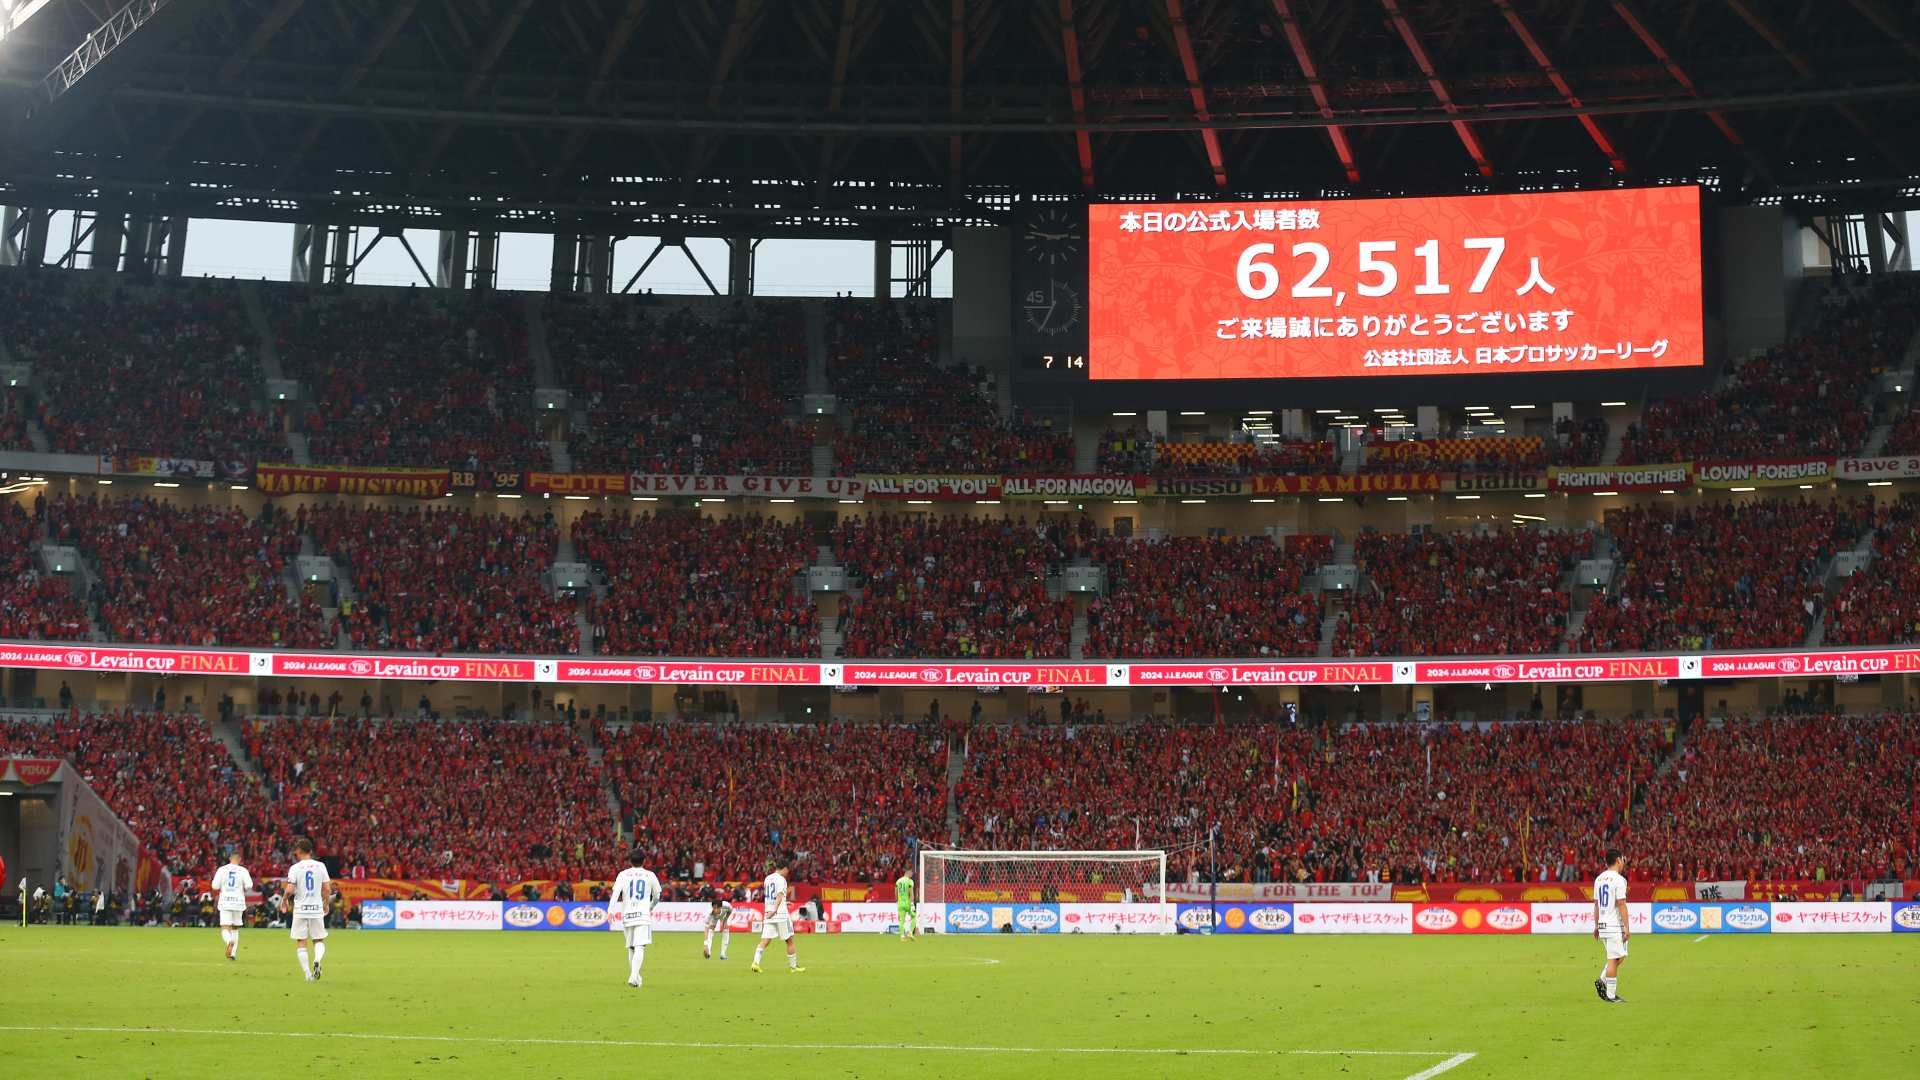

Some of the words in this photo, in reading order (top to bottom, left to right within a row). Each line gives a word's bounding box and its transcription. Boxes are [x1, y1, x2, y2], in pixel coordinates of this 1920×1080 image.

[1120, 208, 1321, 233] 本日の公式入場者数
[1216, 309, 1574, 339] ご来場誠にありがとうございます
[1364, 347, 1469, 367] 公益社団法人
[1476, 338, 1668, 364] 日本プロサッカーリーグ
[1068, 356, 1084, 368] 14
[1701, 464, 1752, 481] LOVIN'
[1757, 461, 1828, 480] FOREVER
[1844, 459, 1899, 474] Have
[338, 477, 444, 496] HISTORY
[529, 473, 625, 491] FONTE
[632, 476, 728, 492] NEVER
[743, 477, 812, 493] GIVE
[826, 480, 864, 496] UP
[868, 478, 901, 494] ALL
[903, 479, 941, 494] FOR
[1255, 477, 1288, 493] LA
[1298, 474, 1440, 494] FAMIGLIA
[1558, 471, 1614, 487] FIGHTIN'
[1616, 468, 1686, 486] TOGETHER
[1004, 478, 1036, 496] ALL
[1036, 479, 1069, 495] FOR
[1069, 479, 1136, 496] NAGOYA
[90, 652, 144, 669] Levain
[146, 657, 175, 670] CUP
[180, 656, 239, 672] FINAL
[284, 662, 306, 670] 2024
[374, 660, 428, 676] Levain
[431, 665, 460, 678] CUP
[465, 663, 524, 678] FINAL
[1427, 668, 1450, 677] 2024
[1518, 663, 1572, 679] Levain
[1574, 666, 1604, 678] CUP
[1608, 662, 1667, 677] FINAL
[1712, 663, 1735, 672] 2024
[1804, 656, 1858, 672] Levain
[1860, 658, 1888, 671] CUP
[568, 668, 590, 676] 2024
[659, 666, 713, 682] Levain
[716, 670, 745, 682] CUP
[752, 668, 808, 682] FINAL
[854, 671, 876, 679] 2024
[946, 668, 1000, 683] Levain
[1003, 671, 1032, 684] CUP
[1037, 668, 1095, 683] FINAL
[1140, 671, 1162, 680] 2024
[1232, 668, 1286, 682] Levain
[1288, 670, 1317, 682] CUP
[1323, 666, 1382, 682] FINAL
[228, 872, 236, 888] 5
[305, 870, 314, 891] 6
[630, 880, 646, 900] 19
[1263, 884, 1297, 897] FOR
[1304, 885, 1341, 896] THE
[1348, 884, 1384, 897] TOP
[419, 910, 498, 920] ヤマザキビスケット
[1320, 912, 1408, 924] ヤマザキビスケット
[1797, 911, 1887, 924] ヤマザキビスケット
